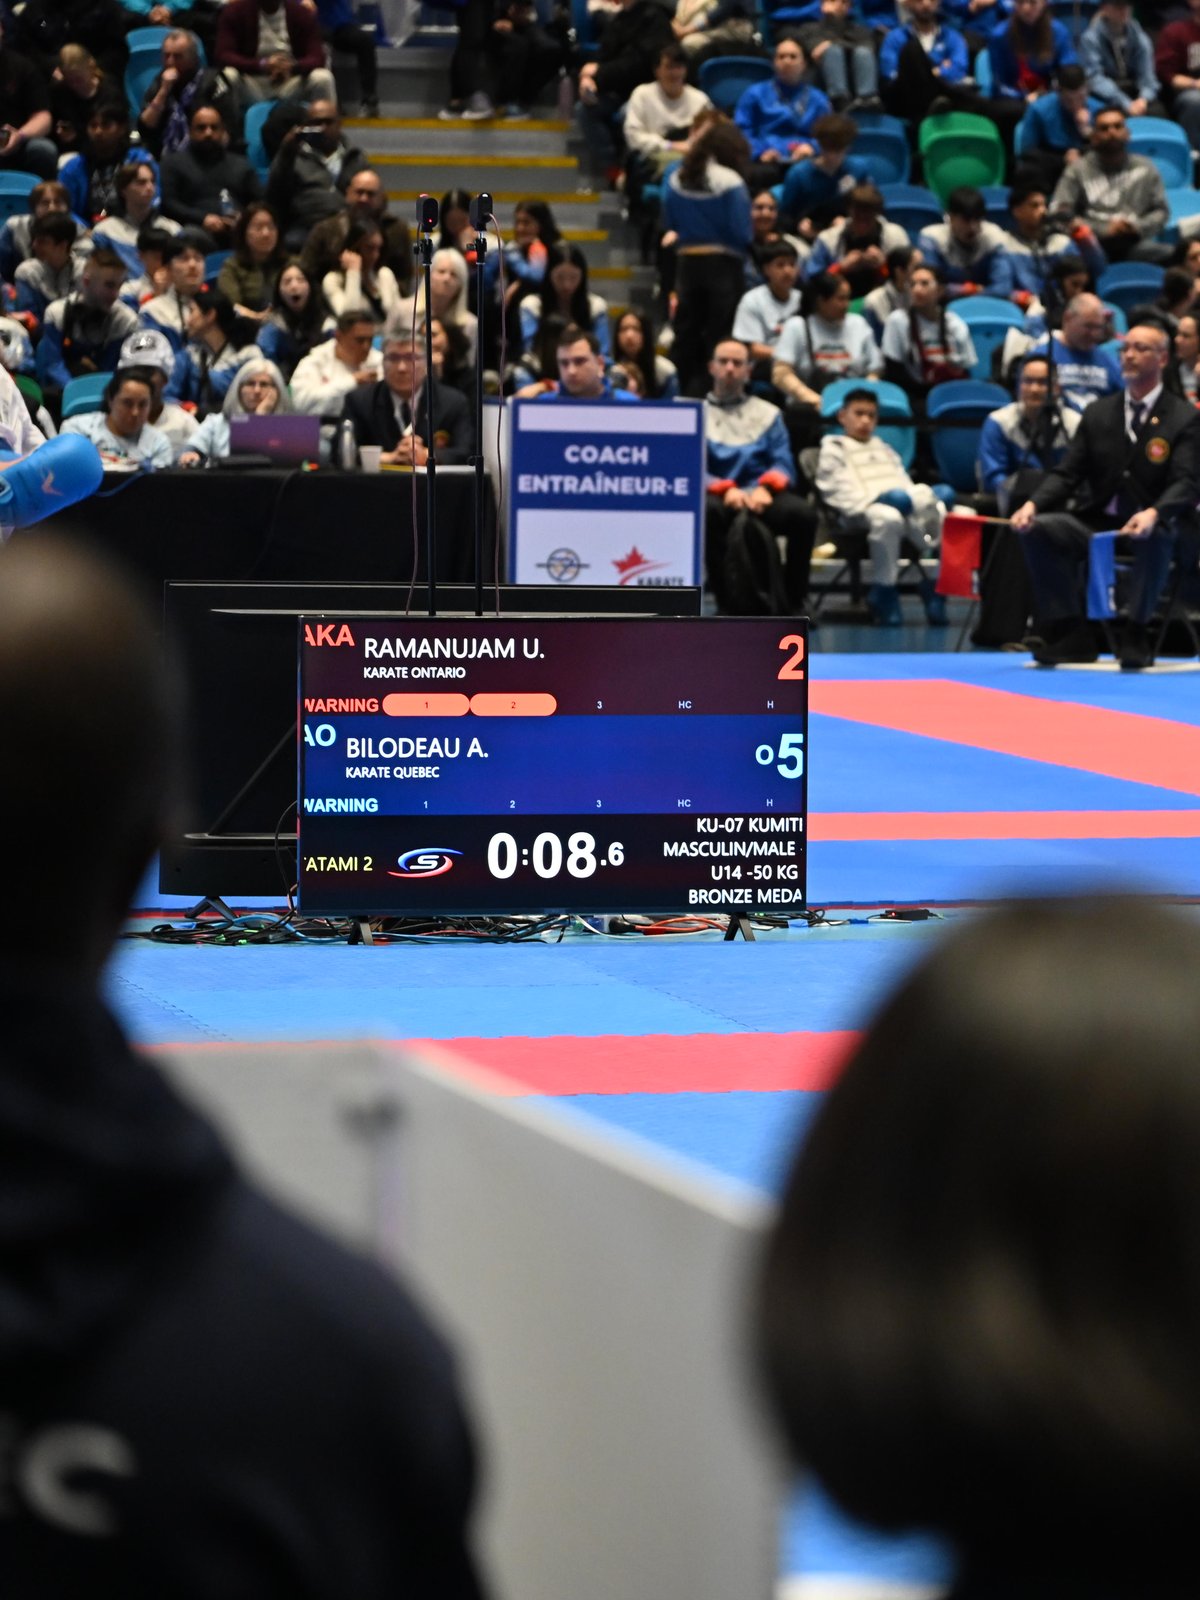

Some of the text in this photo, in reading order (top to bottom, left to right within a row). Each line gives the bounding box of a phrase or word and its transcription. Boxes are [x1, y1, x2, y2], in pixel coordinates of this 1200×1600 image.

[564, 445, 649, 465] COACH
[364, 637, 545, 659] RAMANUJAM U.
[777, 634, 804, 680] 2
[363, 666, 466, 679] KARATE ONTARIO
[424, 701, 429, 709] 1
[511, 701, 516, 709] 2
[597, 701, 603, 709] 3
[678, 700, 692, 709] HC
[767, 700, 774, 709] H
[347, 737, 489, 758] BILODEAU A.
[345, 766, 440, 780] KARATE QUEBEC
[423, 800, 428, 809] 1
[509, 800, 516, 809] 2
[596, 799, 602, 808] 3
[677, 799, 691, 808] HC
[766, 799, 773, 807] H
[696, 817, 744, 833] KU-07
[663, 841, 796, 858] MASCULIN/MALE
[304, 856, 373, 872] ATAMI 2
[711, 865, 798, 880] U14 -50 KG
[688, 889, 752, 904] BRONZE
